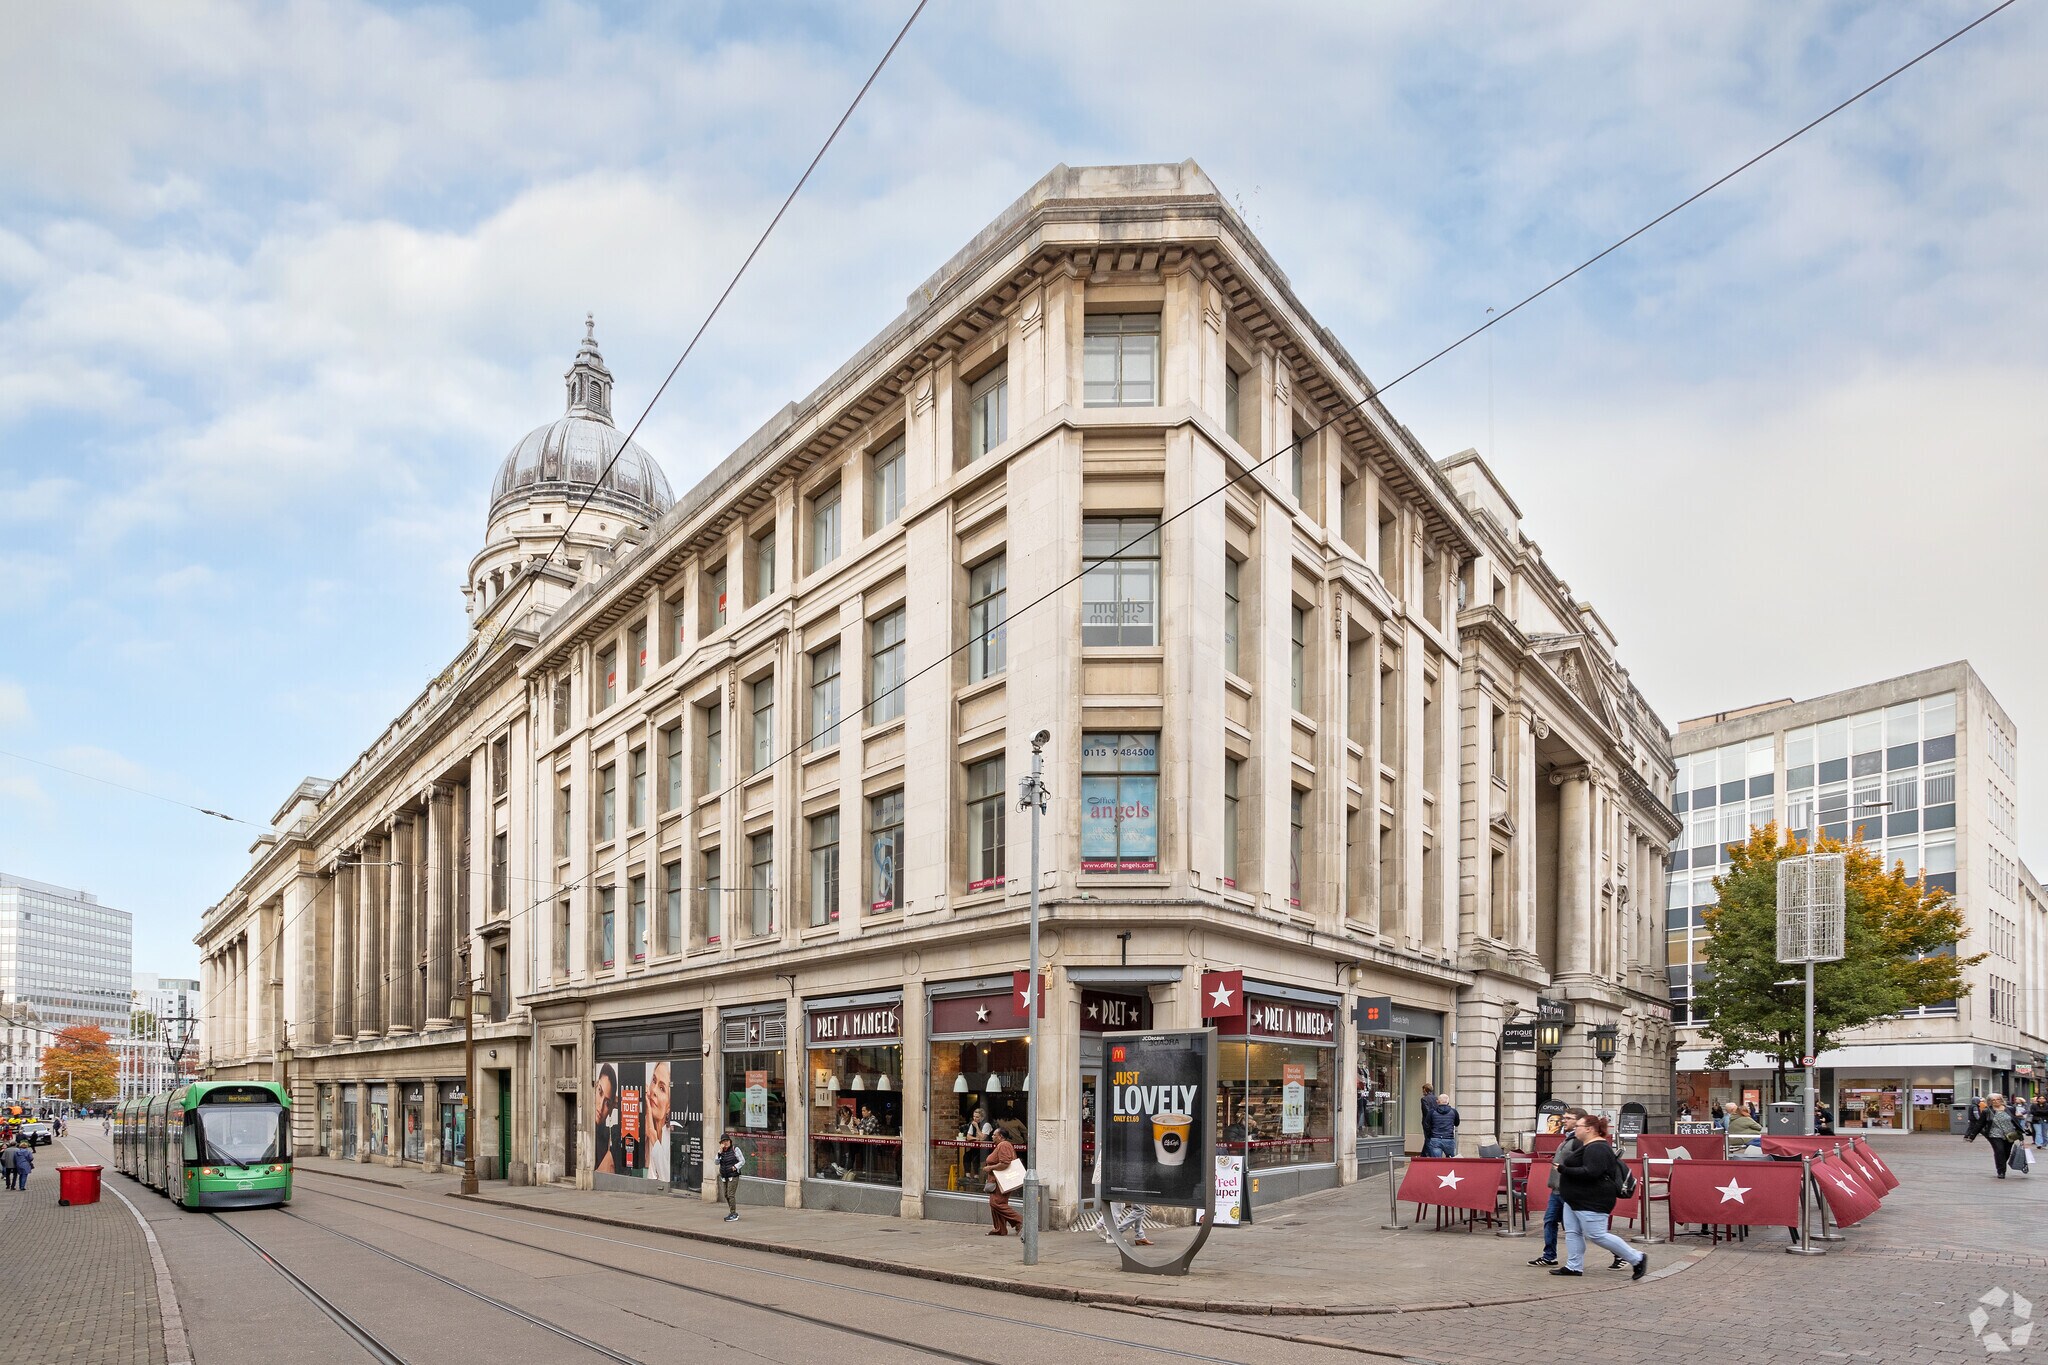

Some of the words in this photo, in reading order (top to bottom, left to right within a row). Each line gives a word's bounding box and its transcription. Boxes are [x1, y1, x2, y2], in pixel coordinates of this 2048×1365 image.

[1090, 800, 1150, 822] angels
[1102, 1000, 1126, 1026] PRET
[1264, 1006, 1284, 1031] PRET
[1286, 1010, 1292, 1032] A
[1296, 1010, 1325, 1035] MANGER
[817, 1016, 838, 1038] PRET
[842, 1015, 848, 1036] A
[854, 1011, 894, 1034] MANGER
[1113, 1072, 1140, 1085] JUST
[623, 1104, 629, 1112] TO
[630, 1104, 638, 1112] LET
[1114, 1085, 1198, 1114] LOVELY
[1218, 1177, 1237, 1187] Feel
[1216, 1189, 1239, 1198] uper
